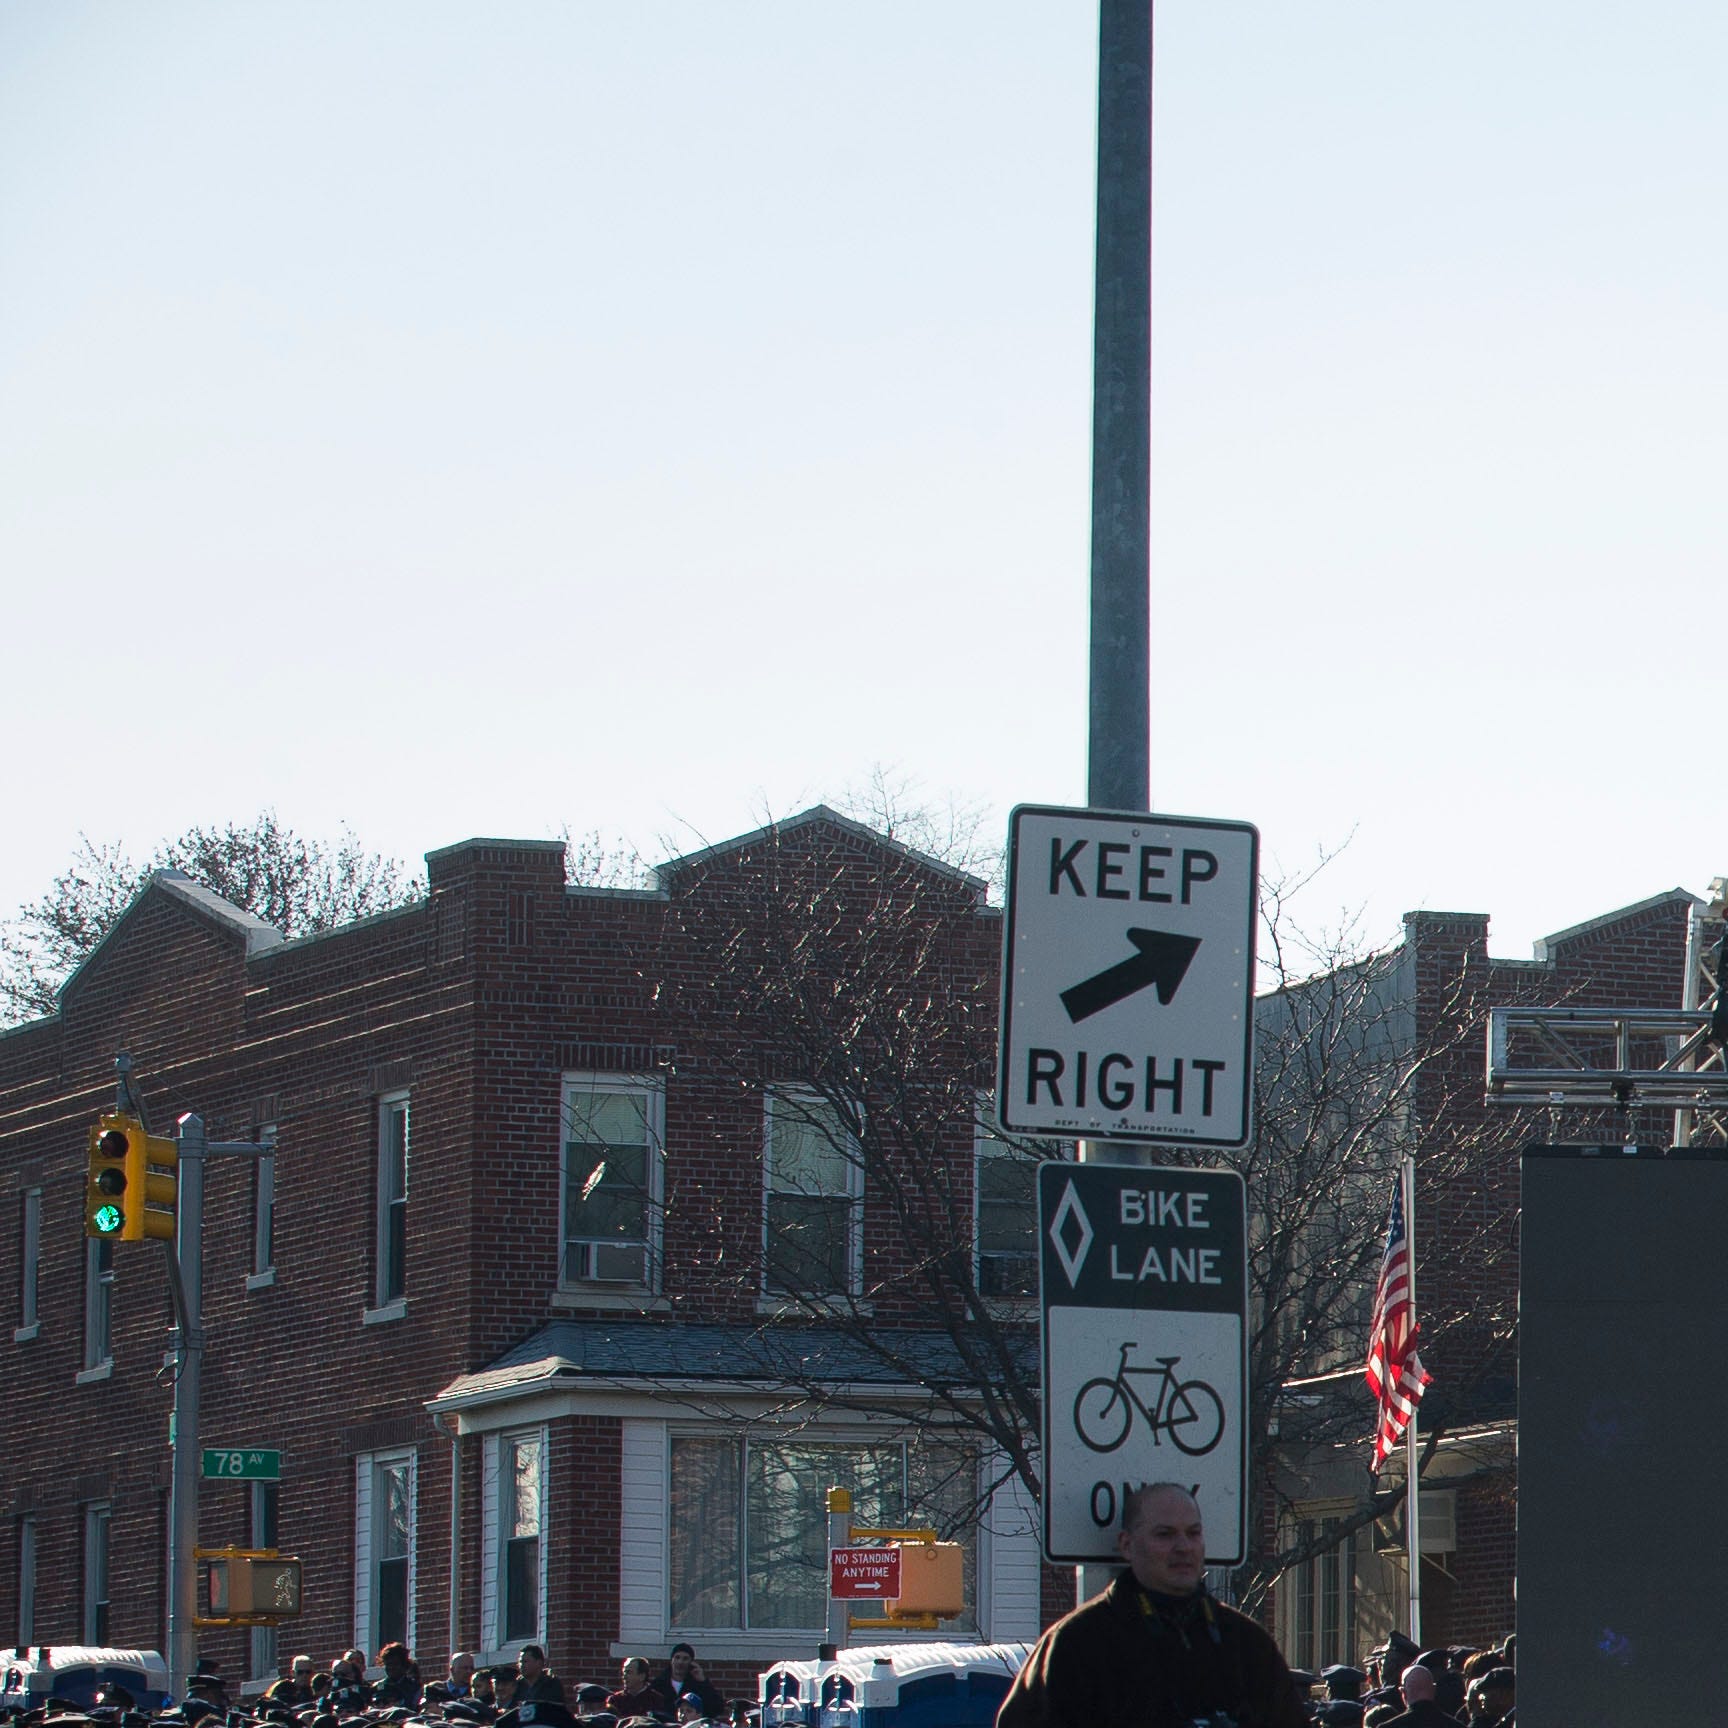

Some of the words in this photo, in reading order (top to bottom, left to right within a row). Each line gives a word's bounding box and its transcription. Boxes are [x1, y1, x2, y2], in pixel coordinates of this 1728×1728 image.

[1050, 837, 1219, 905] KEEP
[1026, 1047, 1226, 1117] RIGHT
[1055, 1119, 1080, 1127] DEPT
[1112, 1122, 1196, 1135] TRANSPORTATION
[1120, 1188, 1210, 1228] BIKE
[1110, 1244, 1222, 1286] LANE
[213, 1452, 244, 1475] 78
[249, 1452, 265, 1465] AV
[834, 1553, 848, 1565] NO
[851, 1552, 897, 1564] STANDING
[842, 1566, 890, 1578] ANYTIME
